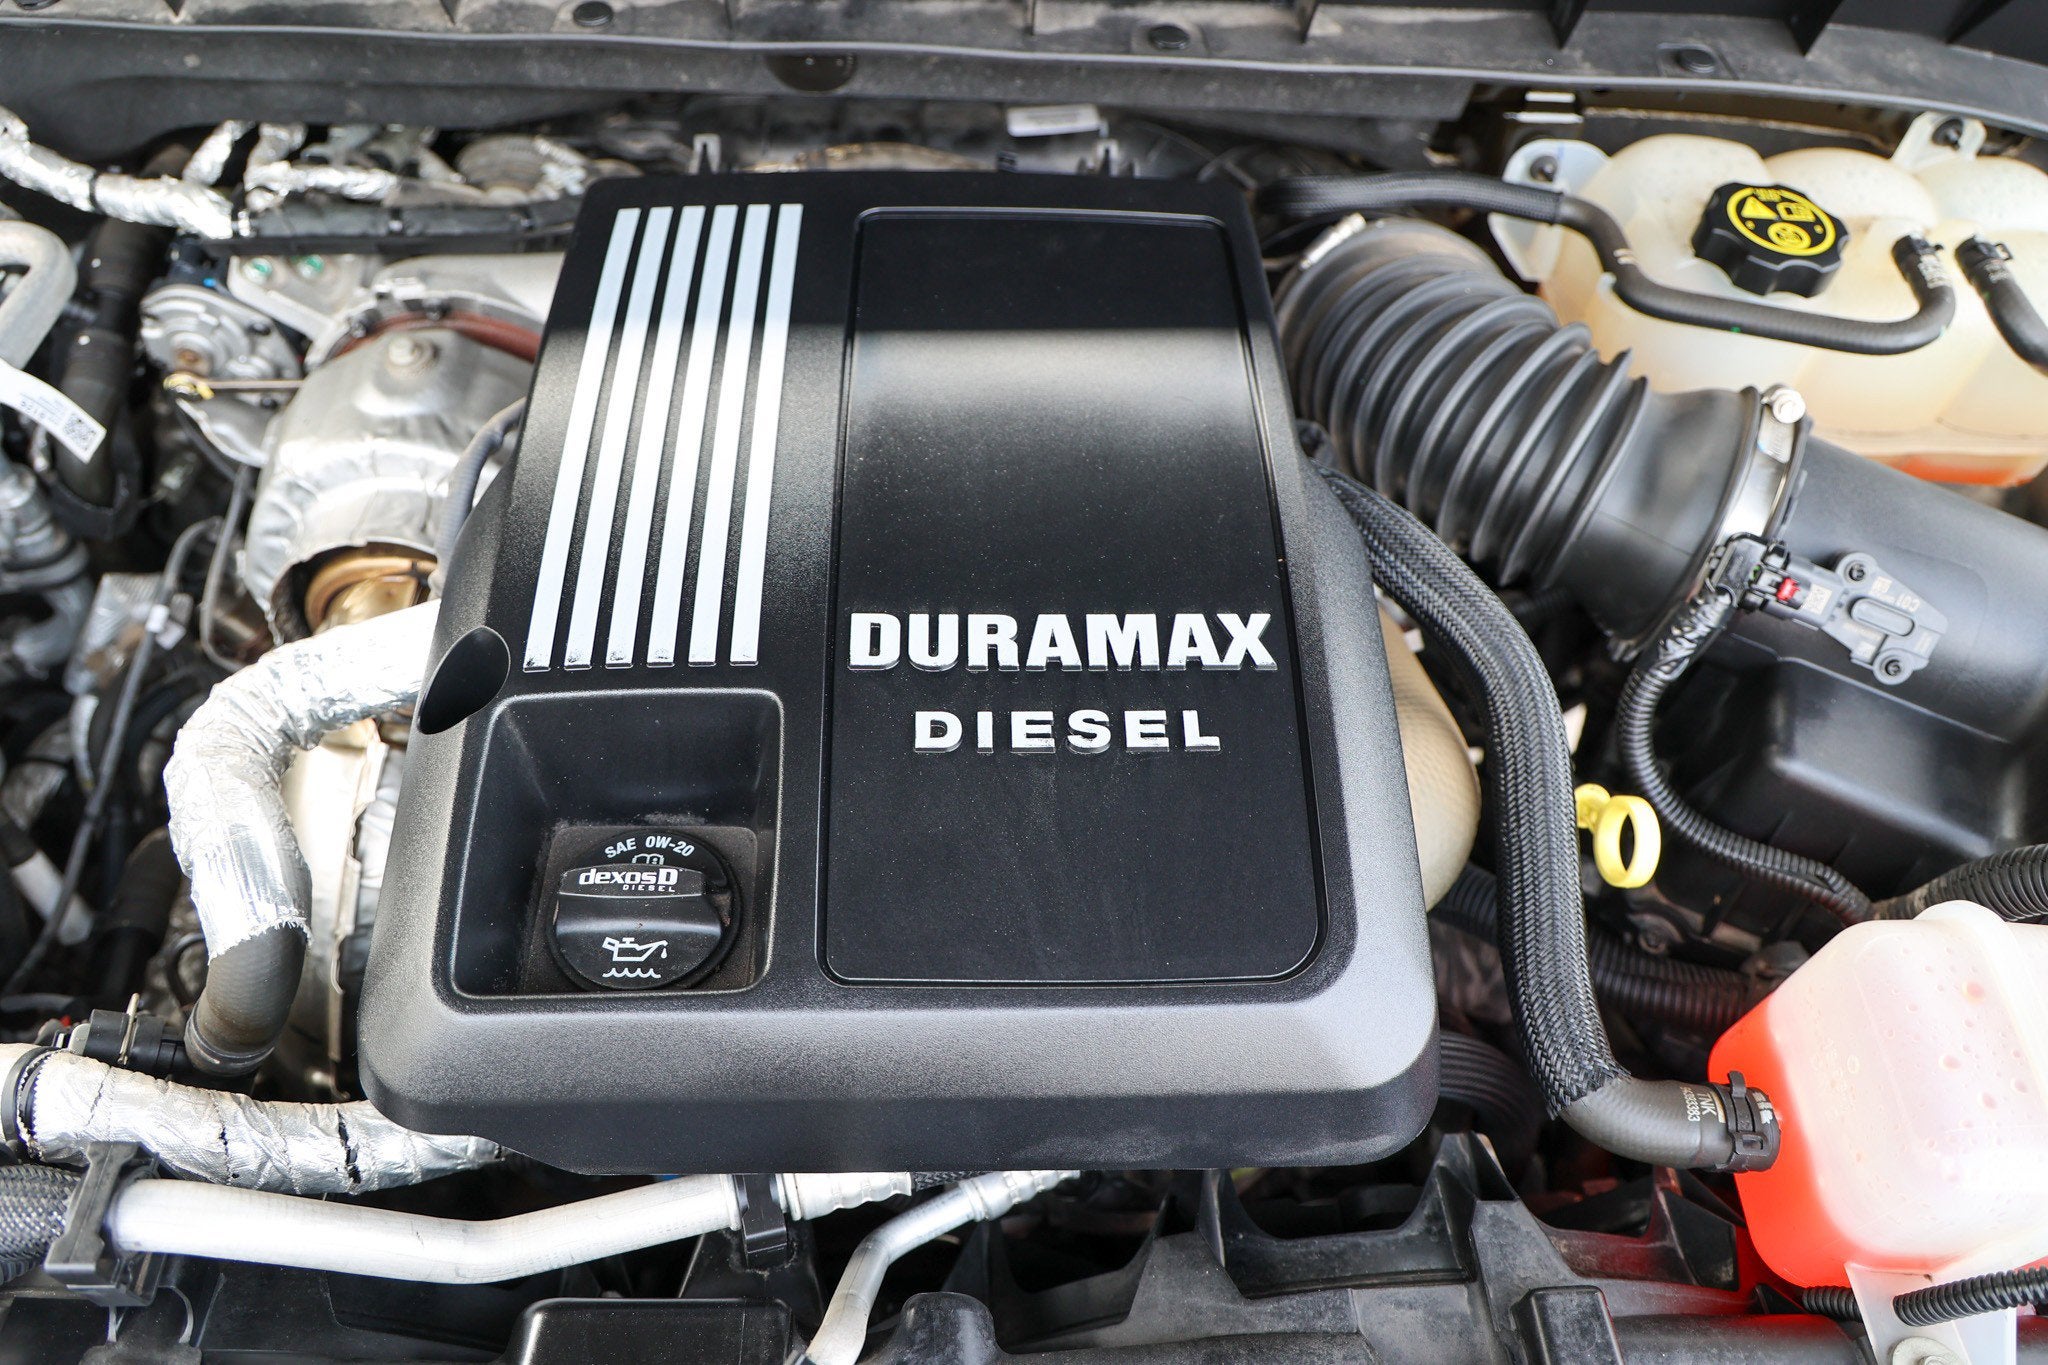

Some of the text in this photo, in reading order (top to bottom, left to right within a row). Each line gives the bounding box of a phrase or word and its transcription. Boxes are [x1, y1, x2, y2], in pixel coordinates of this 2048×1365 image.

[848, 612, 1278, 671] DURAMAX
[914, 709, 1220, 753] DIESEL
[604, 836, 695, 858] SAE 0W-20
[578, 868, 678, 885] dexosD
[622, 884, 676, 892] DIESEL
[1697, 1090, 1717, 1116] TNK
